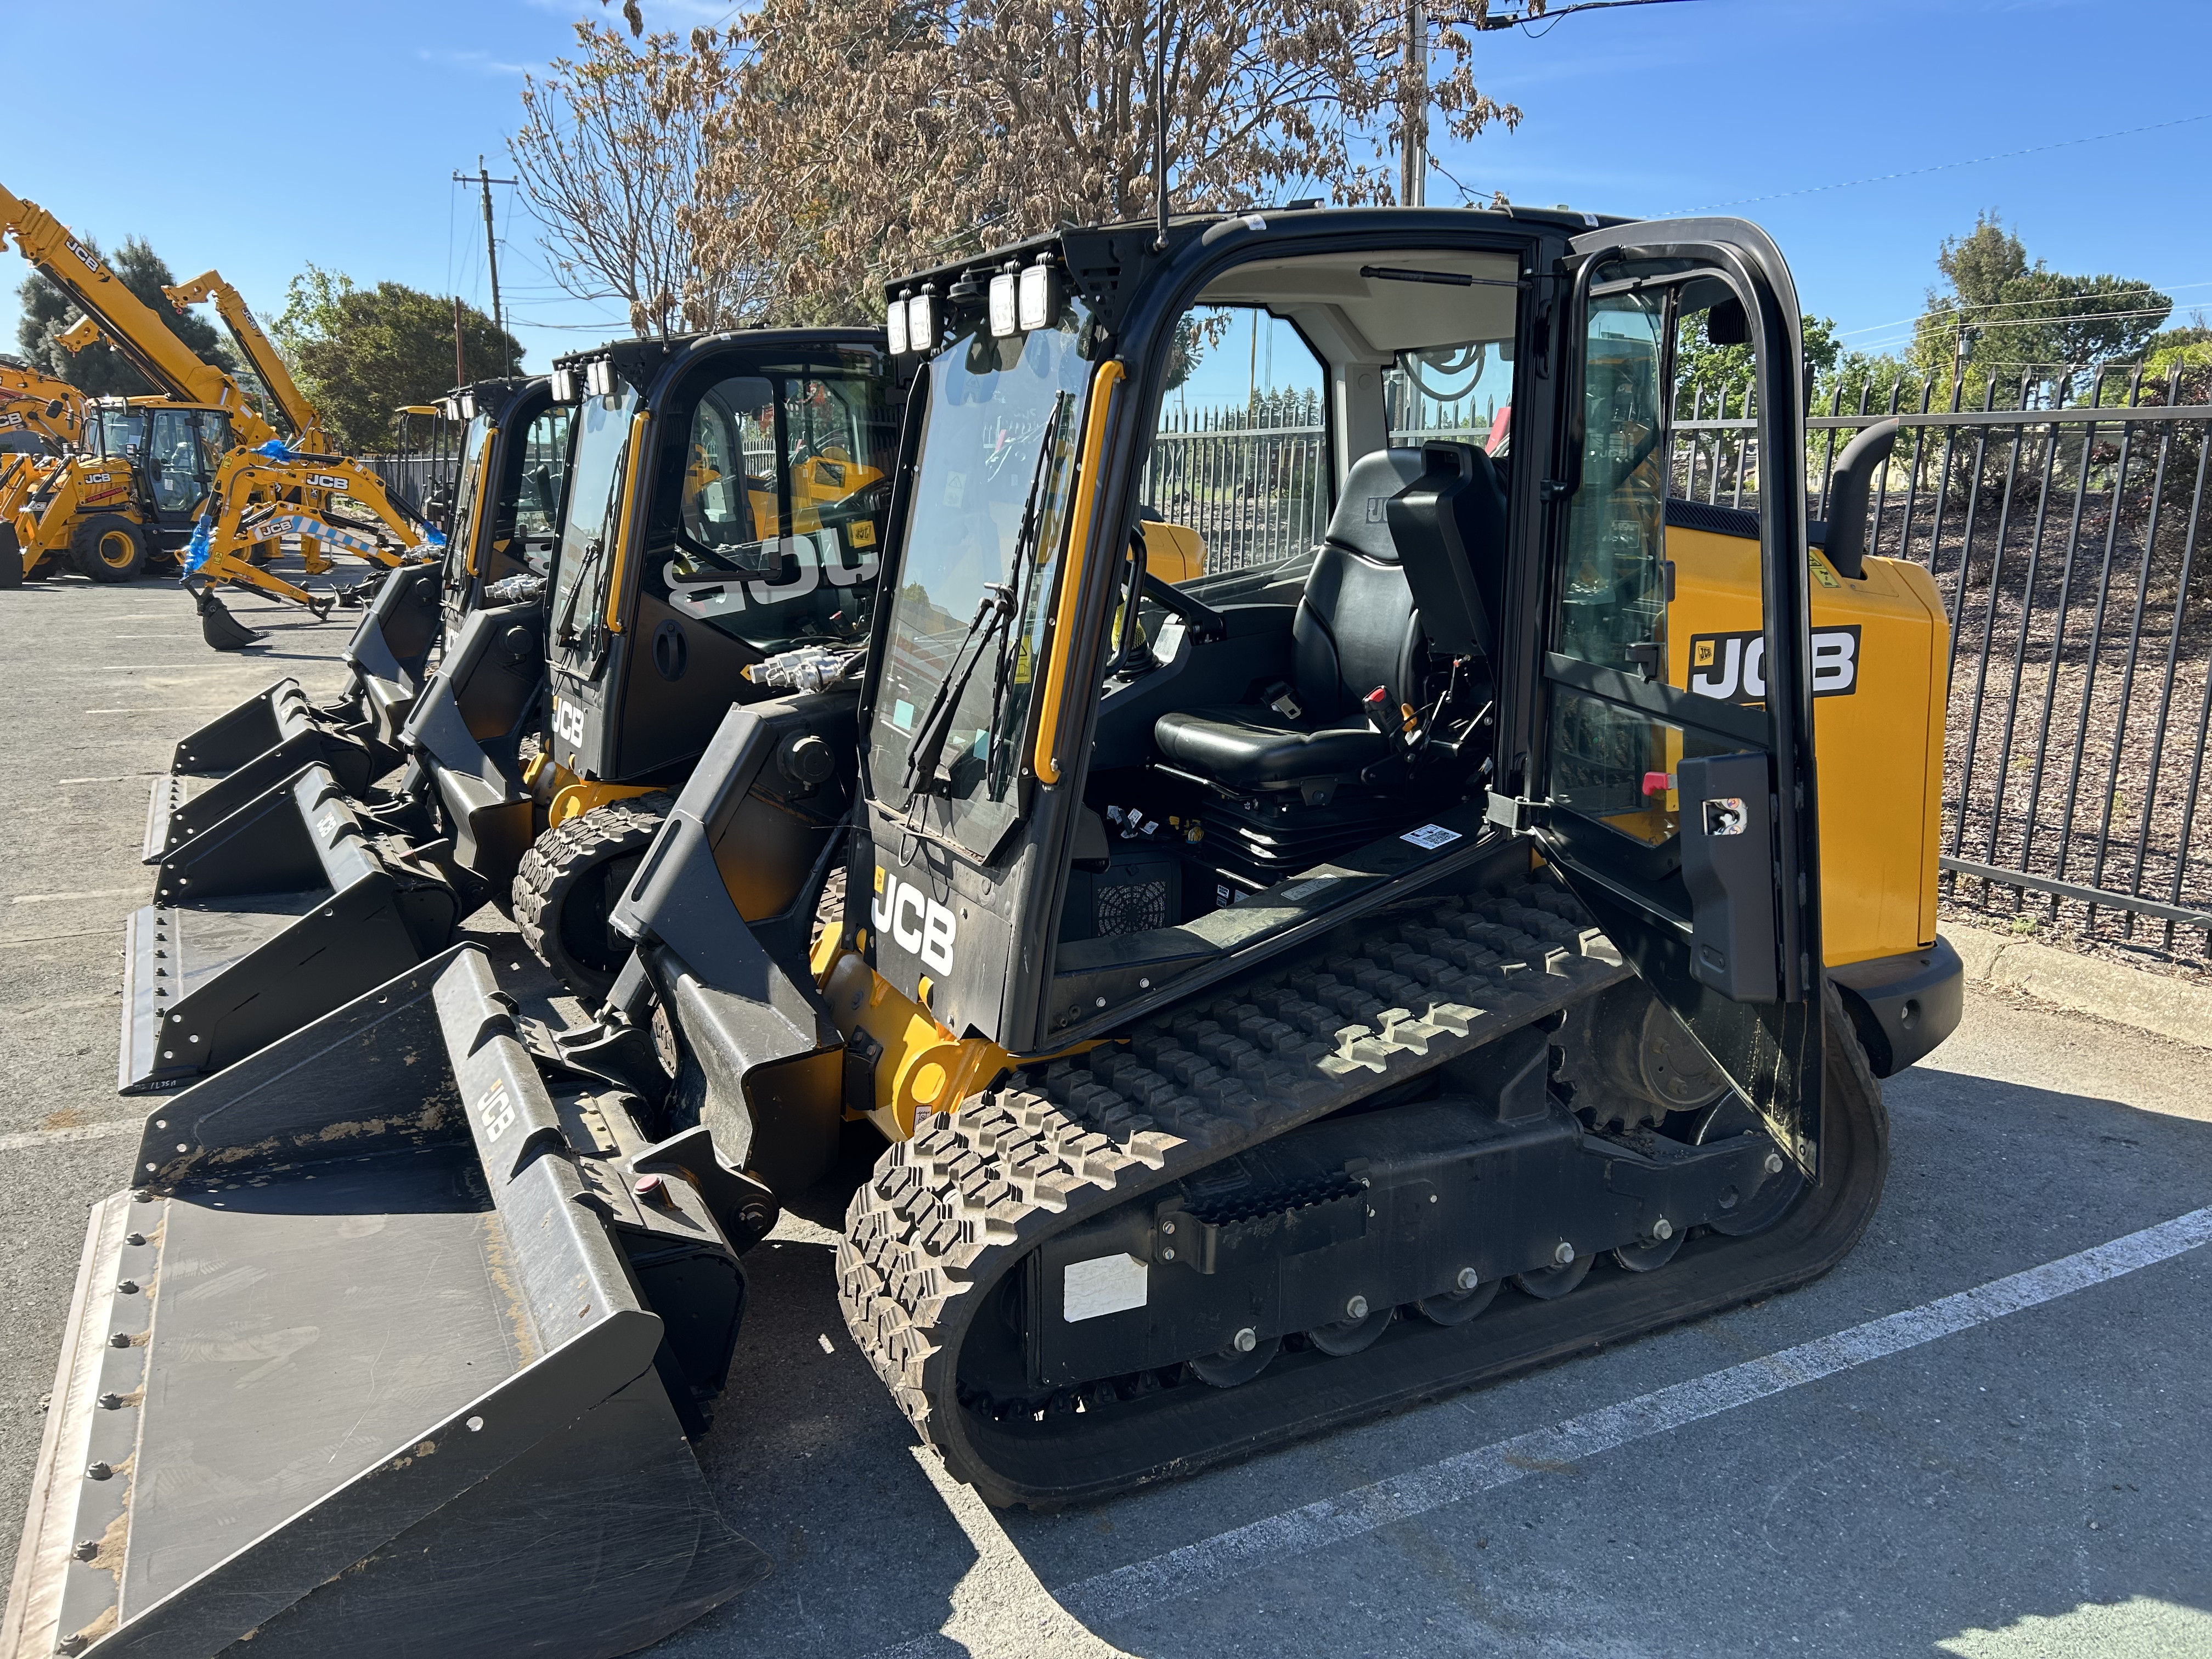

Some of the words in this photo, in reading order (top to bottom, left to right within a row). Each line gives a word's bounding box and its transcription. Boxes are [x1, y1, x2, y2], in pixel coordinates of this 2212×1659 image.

[66, 241, 98, 272] JCB
[242, 309, 257, 330] JCB
[0, 413, 22, 427] CB
[85, 473, 111, 483] JCB
[307, 475, 348, 489] JCB
[263, 521, 292, 535] JCB
[1700, 647, 1712, 659] JCB
[551, 697, 584, 748] JCB
[317, 813, 337, 838] JCB
[871, 873, 956, 977] JCB
[477, 1085, 516, 1143] JCB
